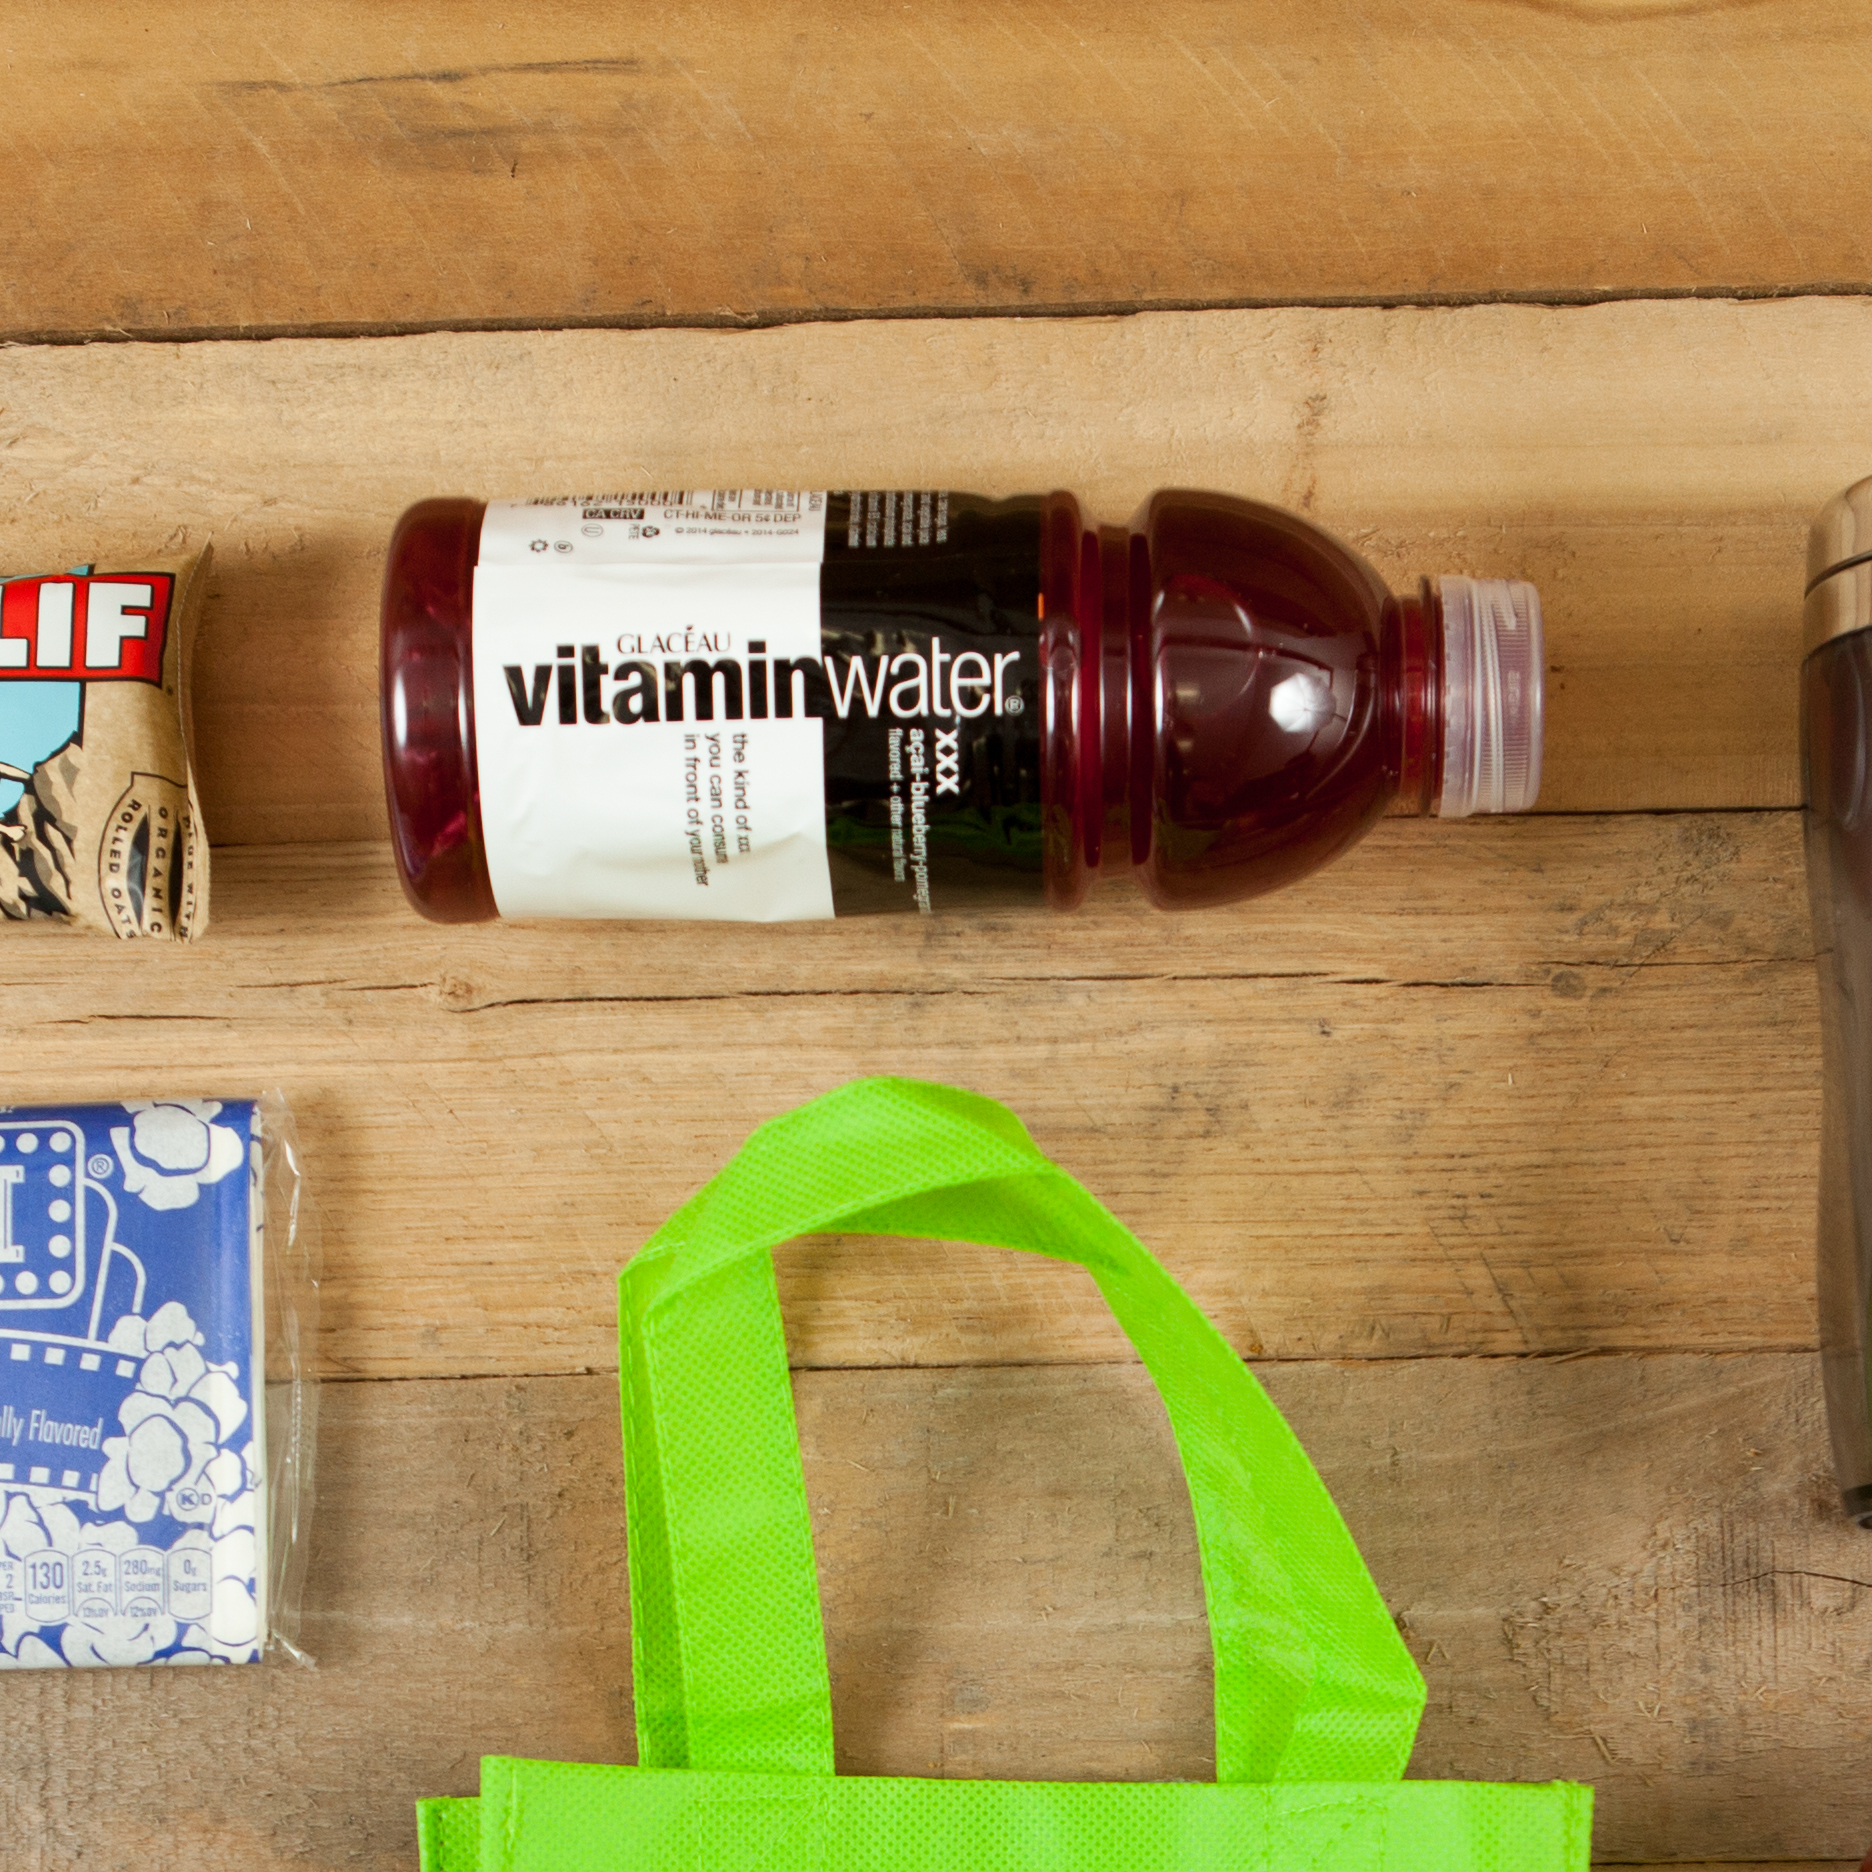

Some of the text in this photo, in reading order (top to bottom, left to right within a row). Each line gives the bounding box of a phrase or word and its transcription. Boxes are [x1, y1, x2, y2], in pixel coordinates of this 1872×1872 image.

[773, 513, 802, 523] DEP
[617, 625, 731, 655] GLACÉAU
[503, 636, 1021, 726] vitaminwater
[684, 734, 700, 750] in
[705, 733, 721, 768] you
[732, 732, 748, 763] the
[888, 728, 904, 780] flavored
[935, 727, 960, 796] xxx
[685, 757, 701, 803] front
[709, 774, 723, 809] can
[733, 770, 750, 810] kind
[687, 808, 704, 826] of
[735, 815, 752, 831] of
[685, 829, 703, 855] your
[109, 799, 142, 938] ROLLED OATS
[150, 806, 169, 933] ORGANIC
[29, 1409, 104, 1450] Flavored
[6, 1573, 14, 1589] 2
[29, 1561, 63, 1589] 130
[97, 1581, 113, 1592] Fat
[124, 1581, 160, 1592] Sodium
[173, 1580, 207, 1593] Sugars
[28, 1593, 66, 1604] Calories
